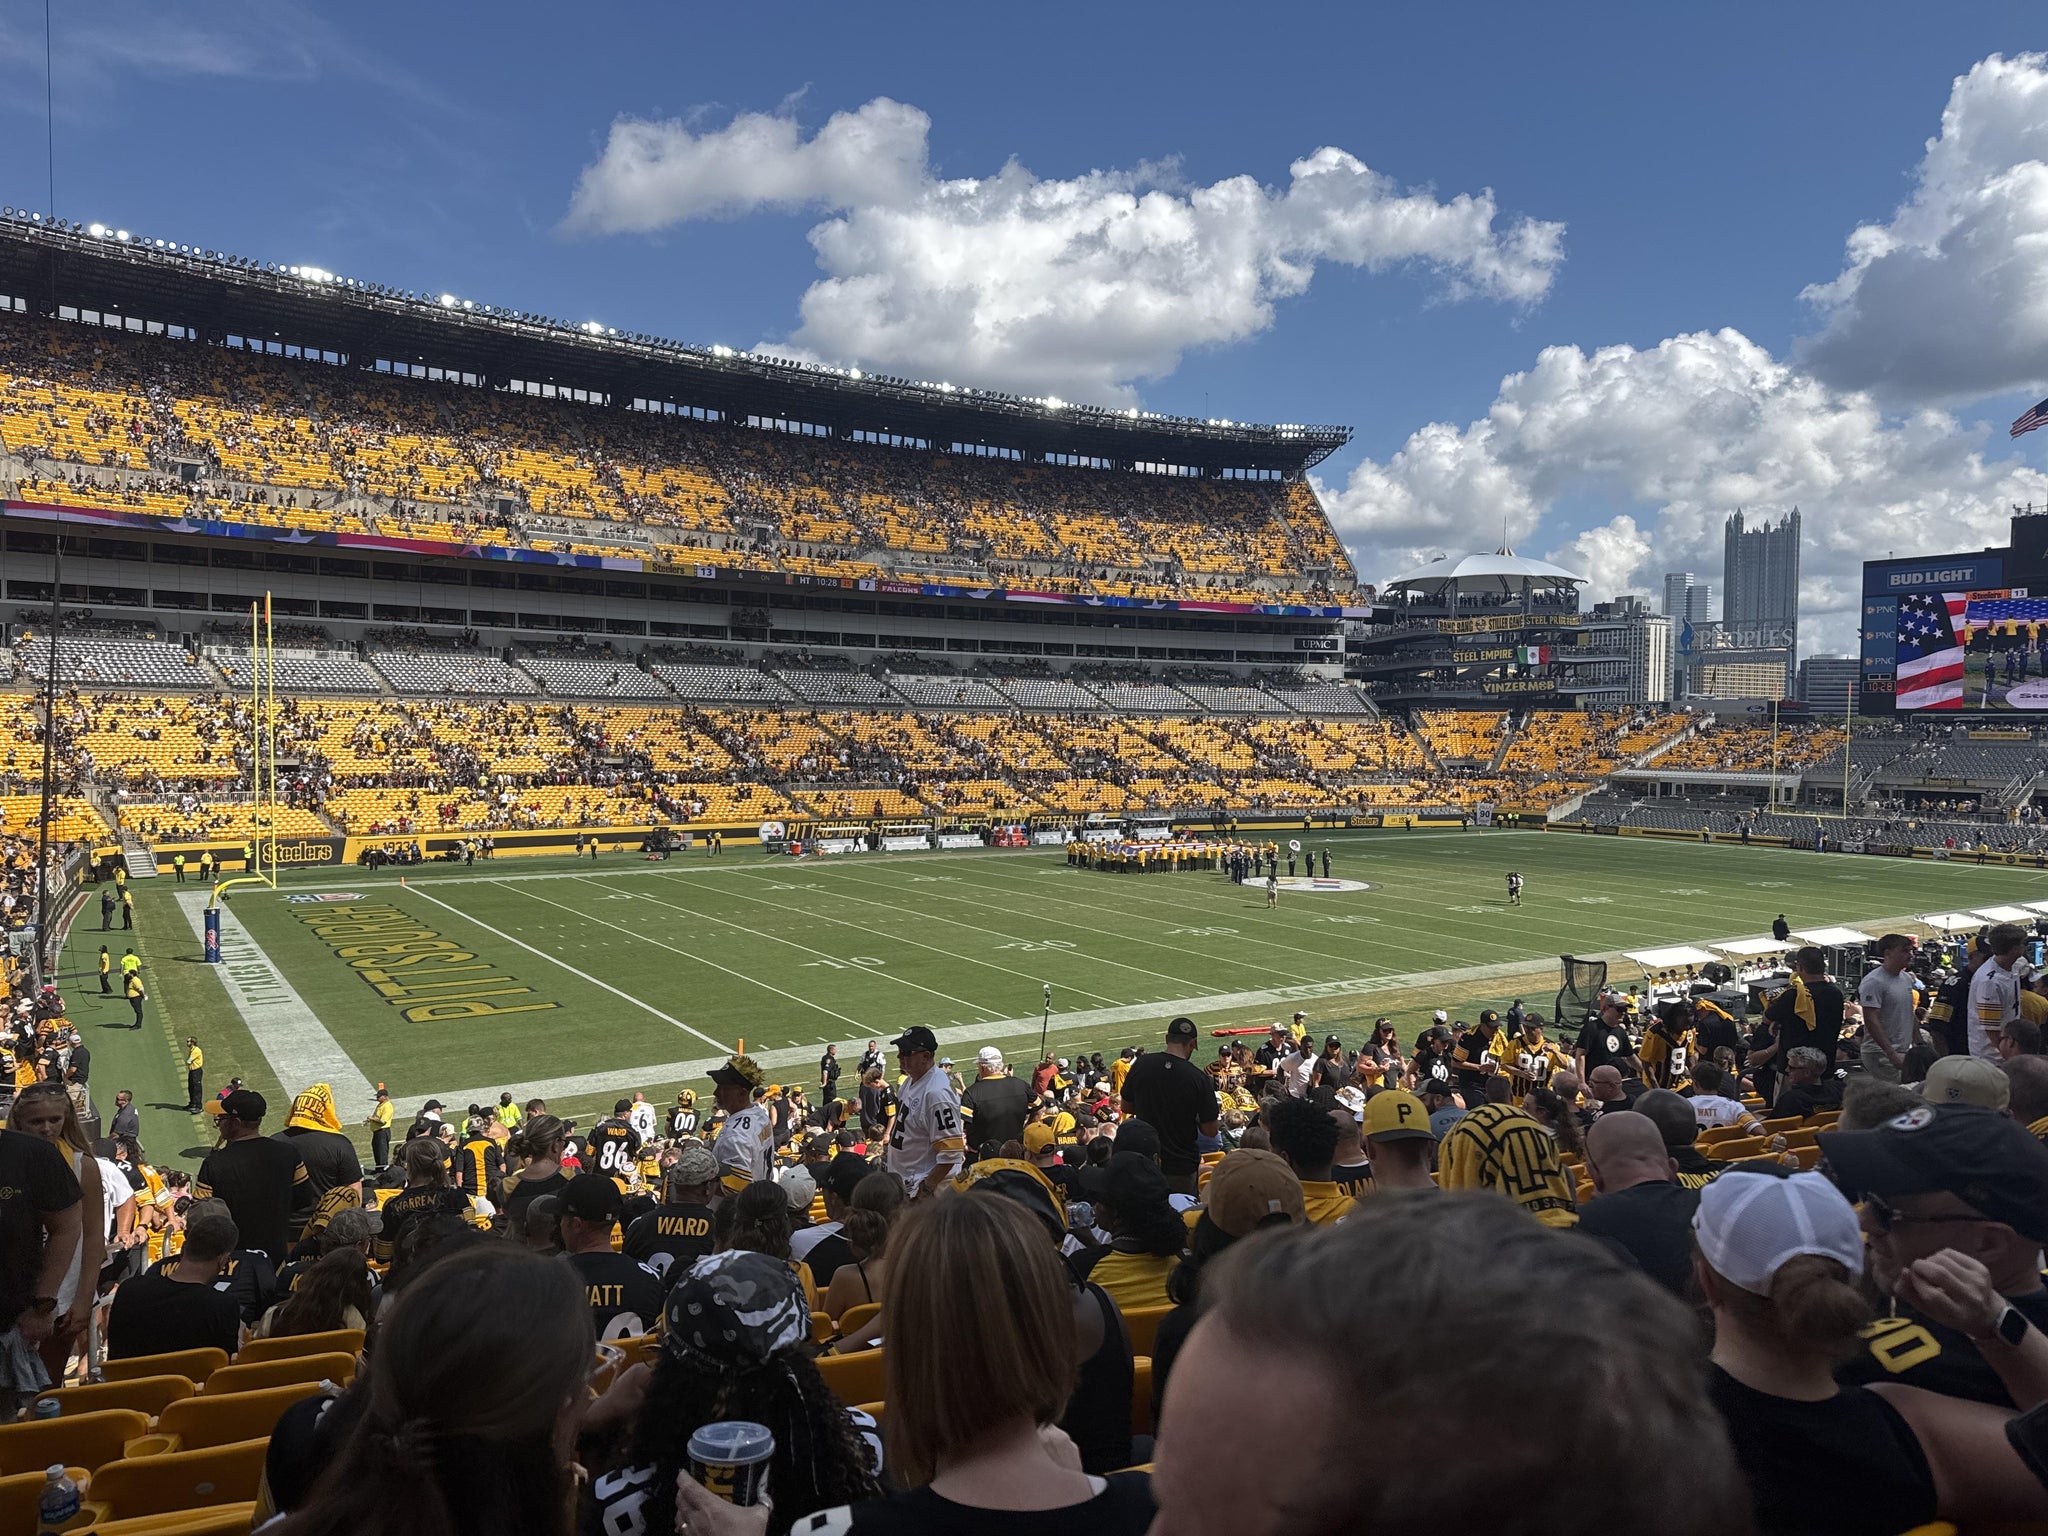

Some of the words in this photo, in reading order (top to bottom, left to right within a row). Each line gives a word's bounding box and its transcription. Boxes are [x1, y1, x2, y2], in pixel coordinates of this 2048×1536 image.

[652, 562, 685, 575] Steelers
[700, 568, 712, 577] 13
[800, 576, 810, 585] HT
[816, 578, 838, 587] 10:28
[1890, 573, 1924, 586] BUD
[1925, 568, 1974, 583] LIGHT
[865, 581, 871, 590] 7
[882, 586, 919, 595] FALCONS
[1972, 592, 2002, 600] Steelers
[1526, 616, 1548, 625] STEEL
[1302, 640, 1331, 649] UPMC
[1699, 628, 1794, 650] PEOPLES
[1453, 650, 1478, 662] STEEL
[1480, 648, 1514, 660] EMPIRE
[1482, 682, 1527, 693] YINZER
[1595, 704, 1618, 712] FORD
[1639, 704, 1663, 712] ZONE
[1480, 810, 1490, 818] 90
[1351, 816, 1378, 826] Steelers
[262, 841, 332, 863] Steelers
[382, 841, 410, 854] 1933
[1176, 926, 1240, 936] 30
[1009, 940, 1078, 952] 20
[286, 903, 564, 1024] PITTSBURGH
[816, 956, 886, 970] 10
[228, 964, 282, 993] TAKES
[1986, 970, 1996, 980] 4
[246, 995, 292, 1006] IT
[1671, 1047, 1686, 1074] 8
[1397, 1103, 1412, 1124] P
[1697, 1108, 1718, 1117] WATT
[639, 1114, 648, 1130] 6
[674, 1112, 696, 1131] 00
[732, 1116, 751, 1130] 78
[934, 1108, 957, 1131] 12
[607, 1128, 626, 1137] WARD
[600, 1140, 628, 1170] 86
[394, 1194, 438, 1212] WARREN
[657, 1216, 710, 1237] WARD
